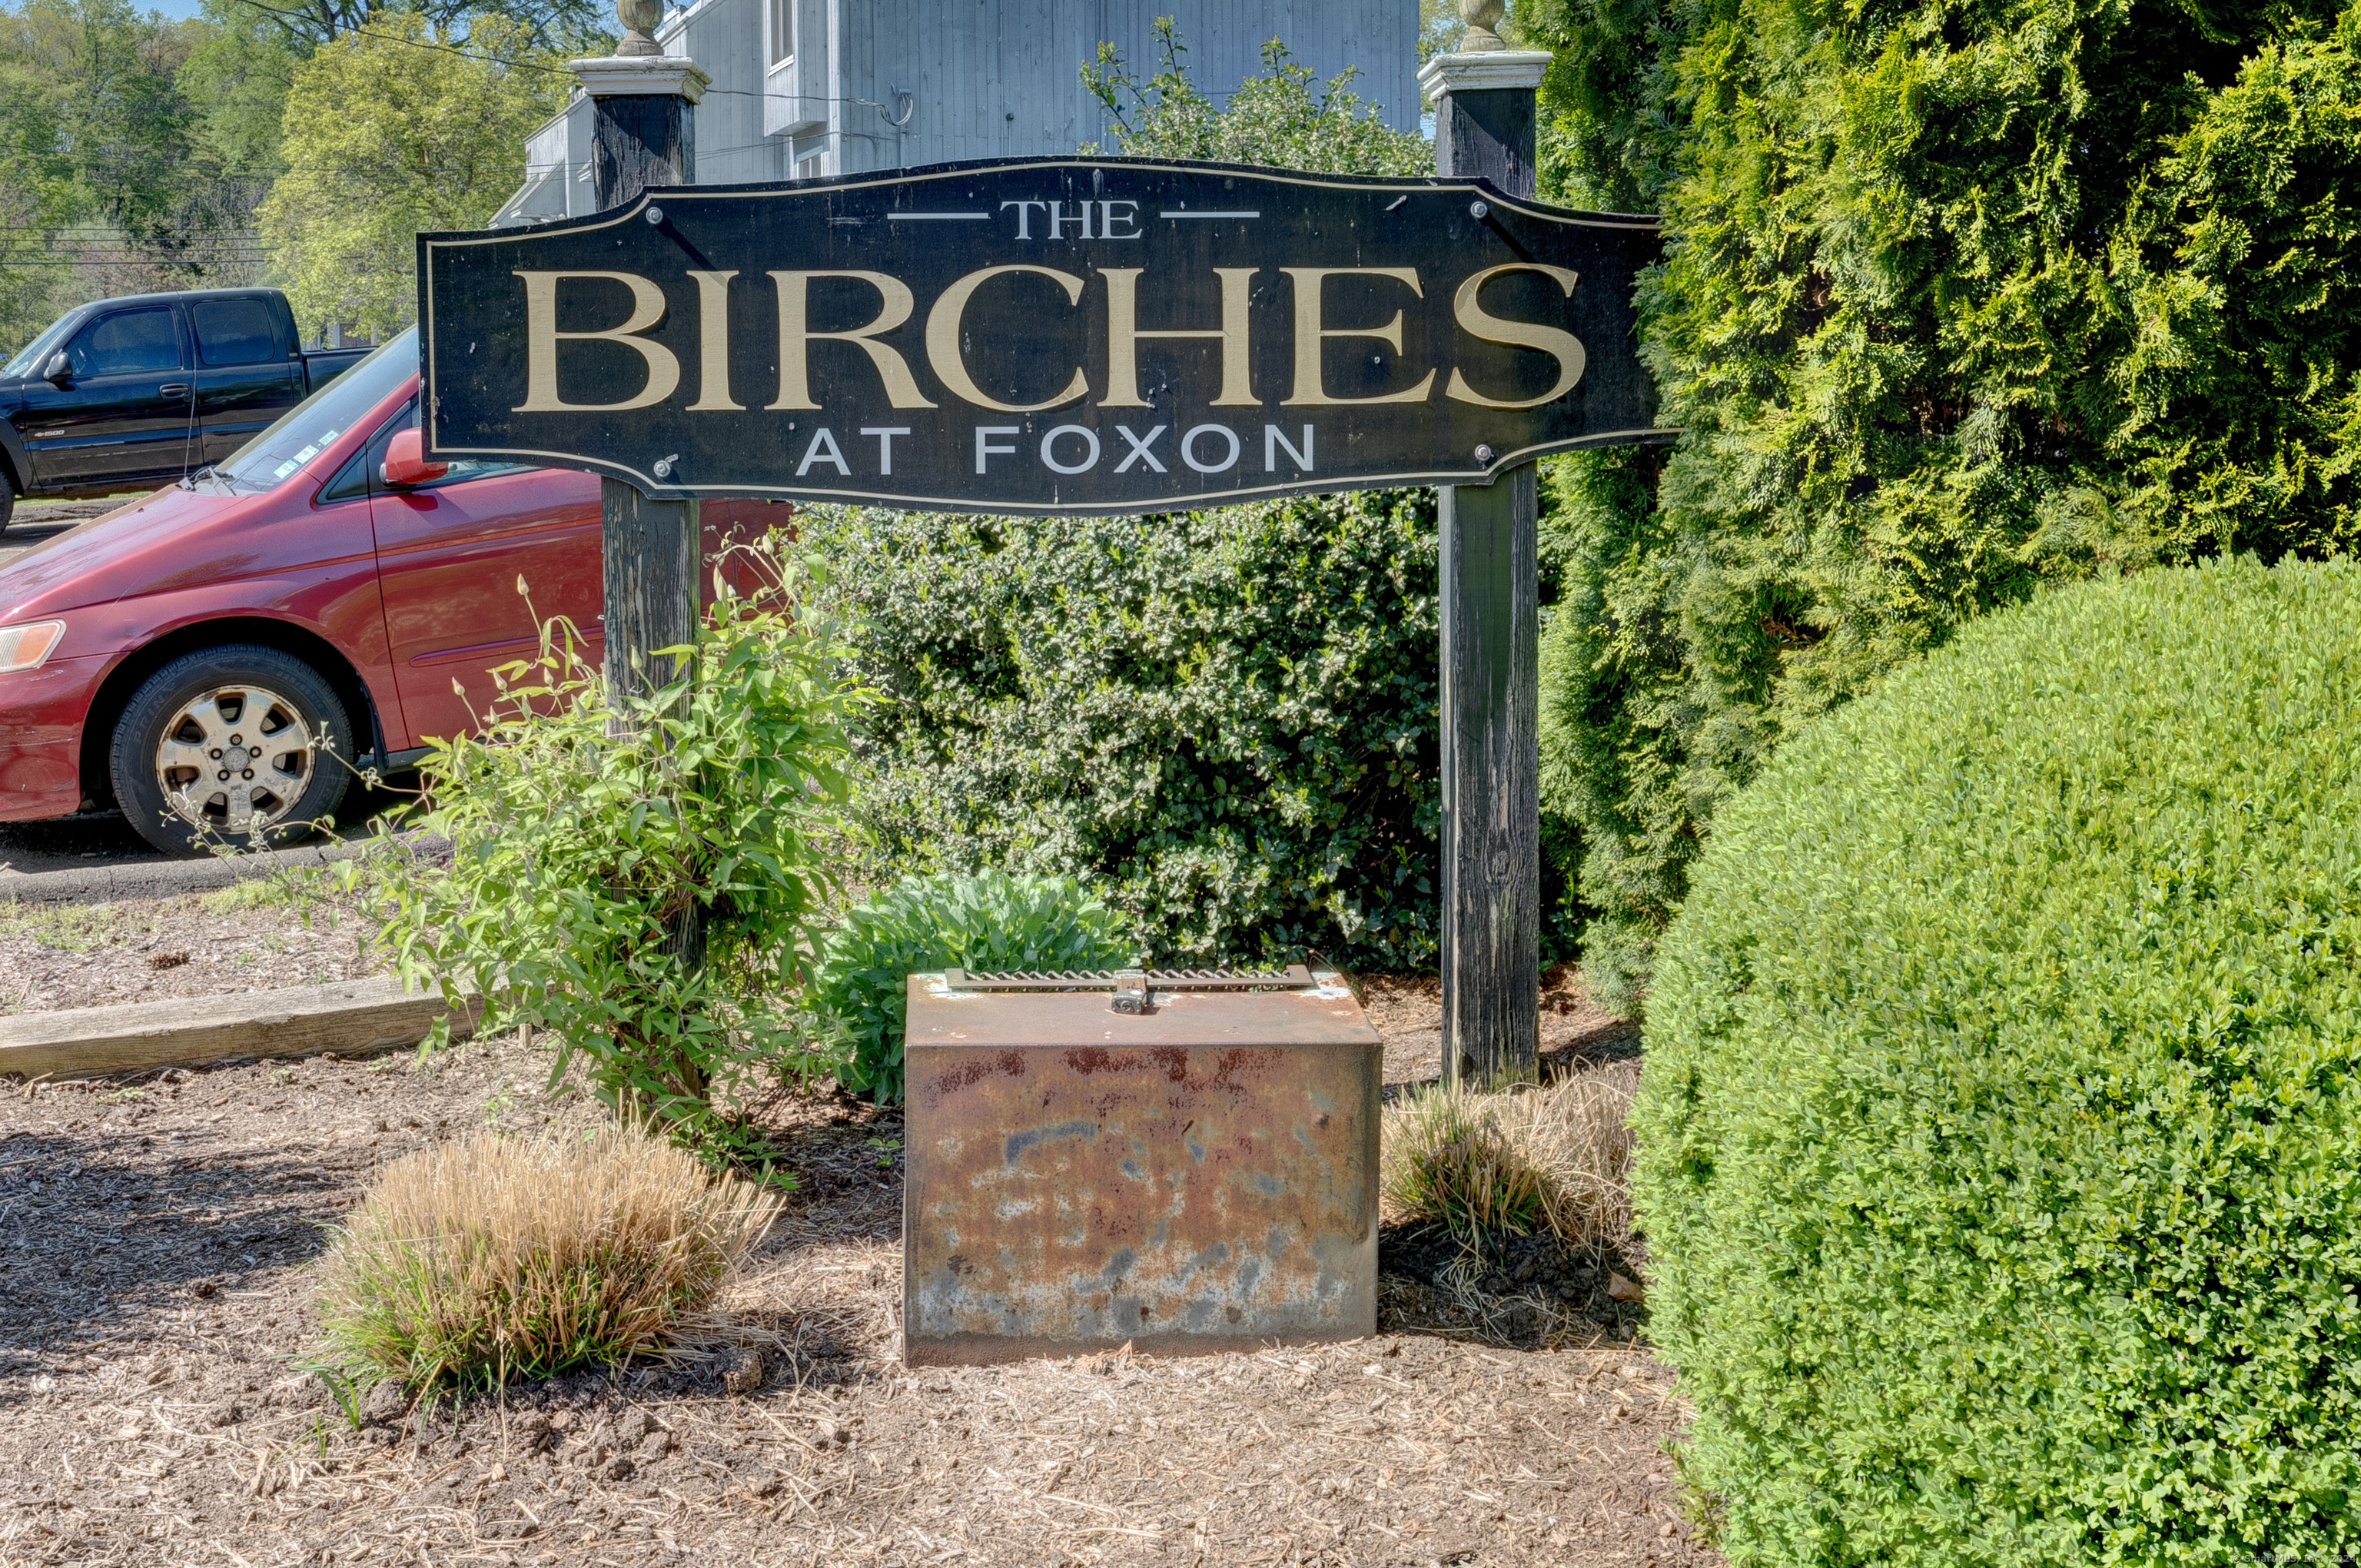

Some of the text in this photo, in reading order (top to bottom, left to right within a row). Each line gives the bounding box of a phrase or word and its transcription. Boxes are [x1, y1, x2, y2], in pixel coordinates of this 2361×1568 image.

[1001, 200, 1142, 241] THE
[511, 263, 1587, 414] BIRCHES
[795, 423, 1314, 477] AT FOXON
